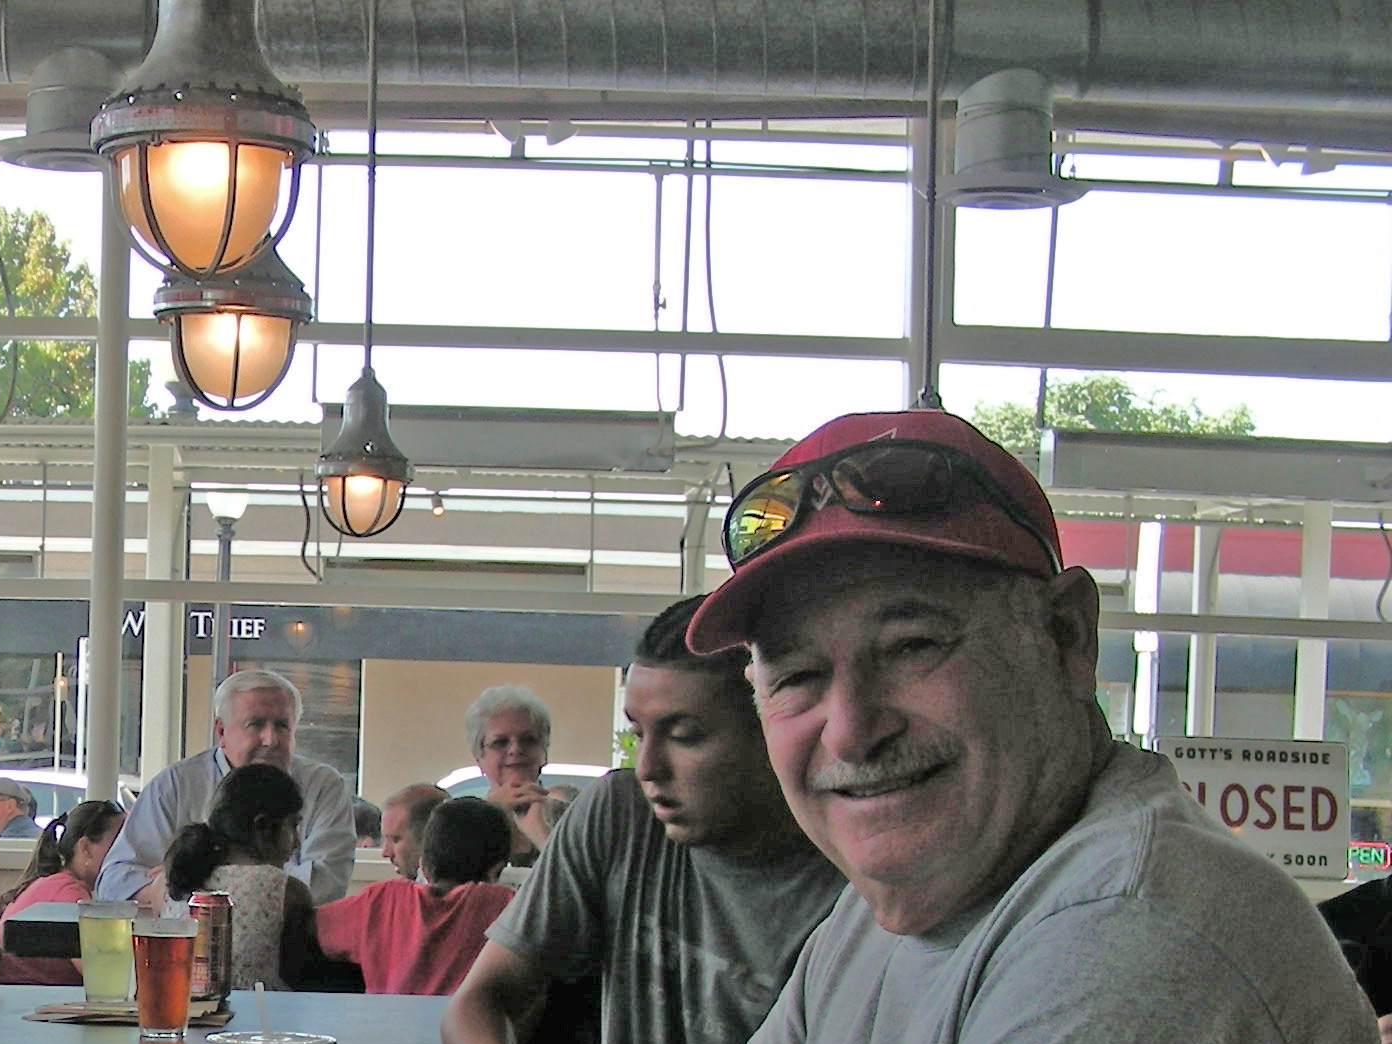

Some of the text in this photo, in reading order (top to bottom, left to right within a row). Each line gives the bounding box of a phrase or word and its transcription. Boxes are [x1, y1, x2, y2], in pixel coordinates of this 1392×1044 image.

[189, 611, 266, 639] TIEF
[1174, 747, 1330, 764] GOTT'S ROADSIDE
[1182, 782, 1338, 833] OSED
[1348, 847, 1384, 864] PEN
